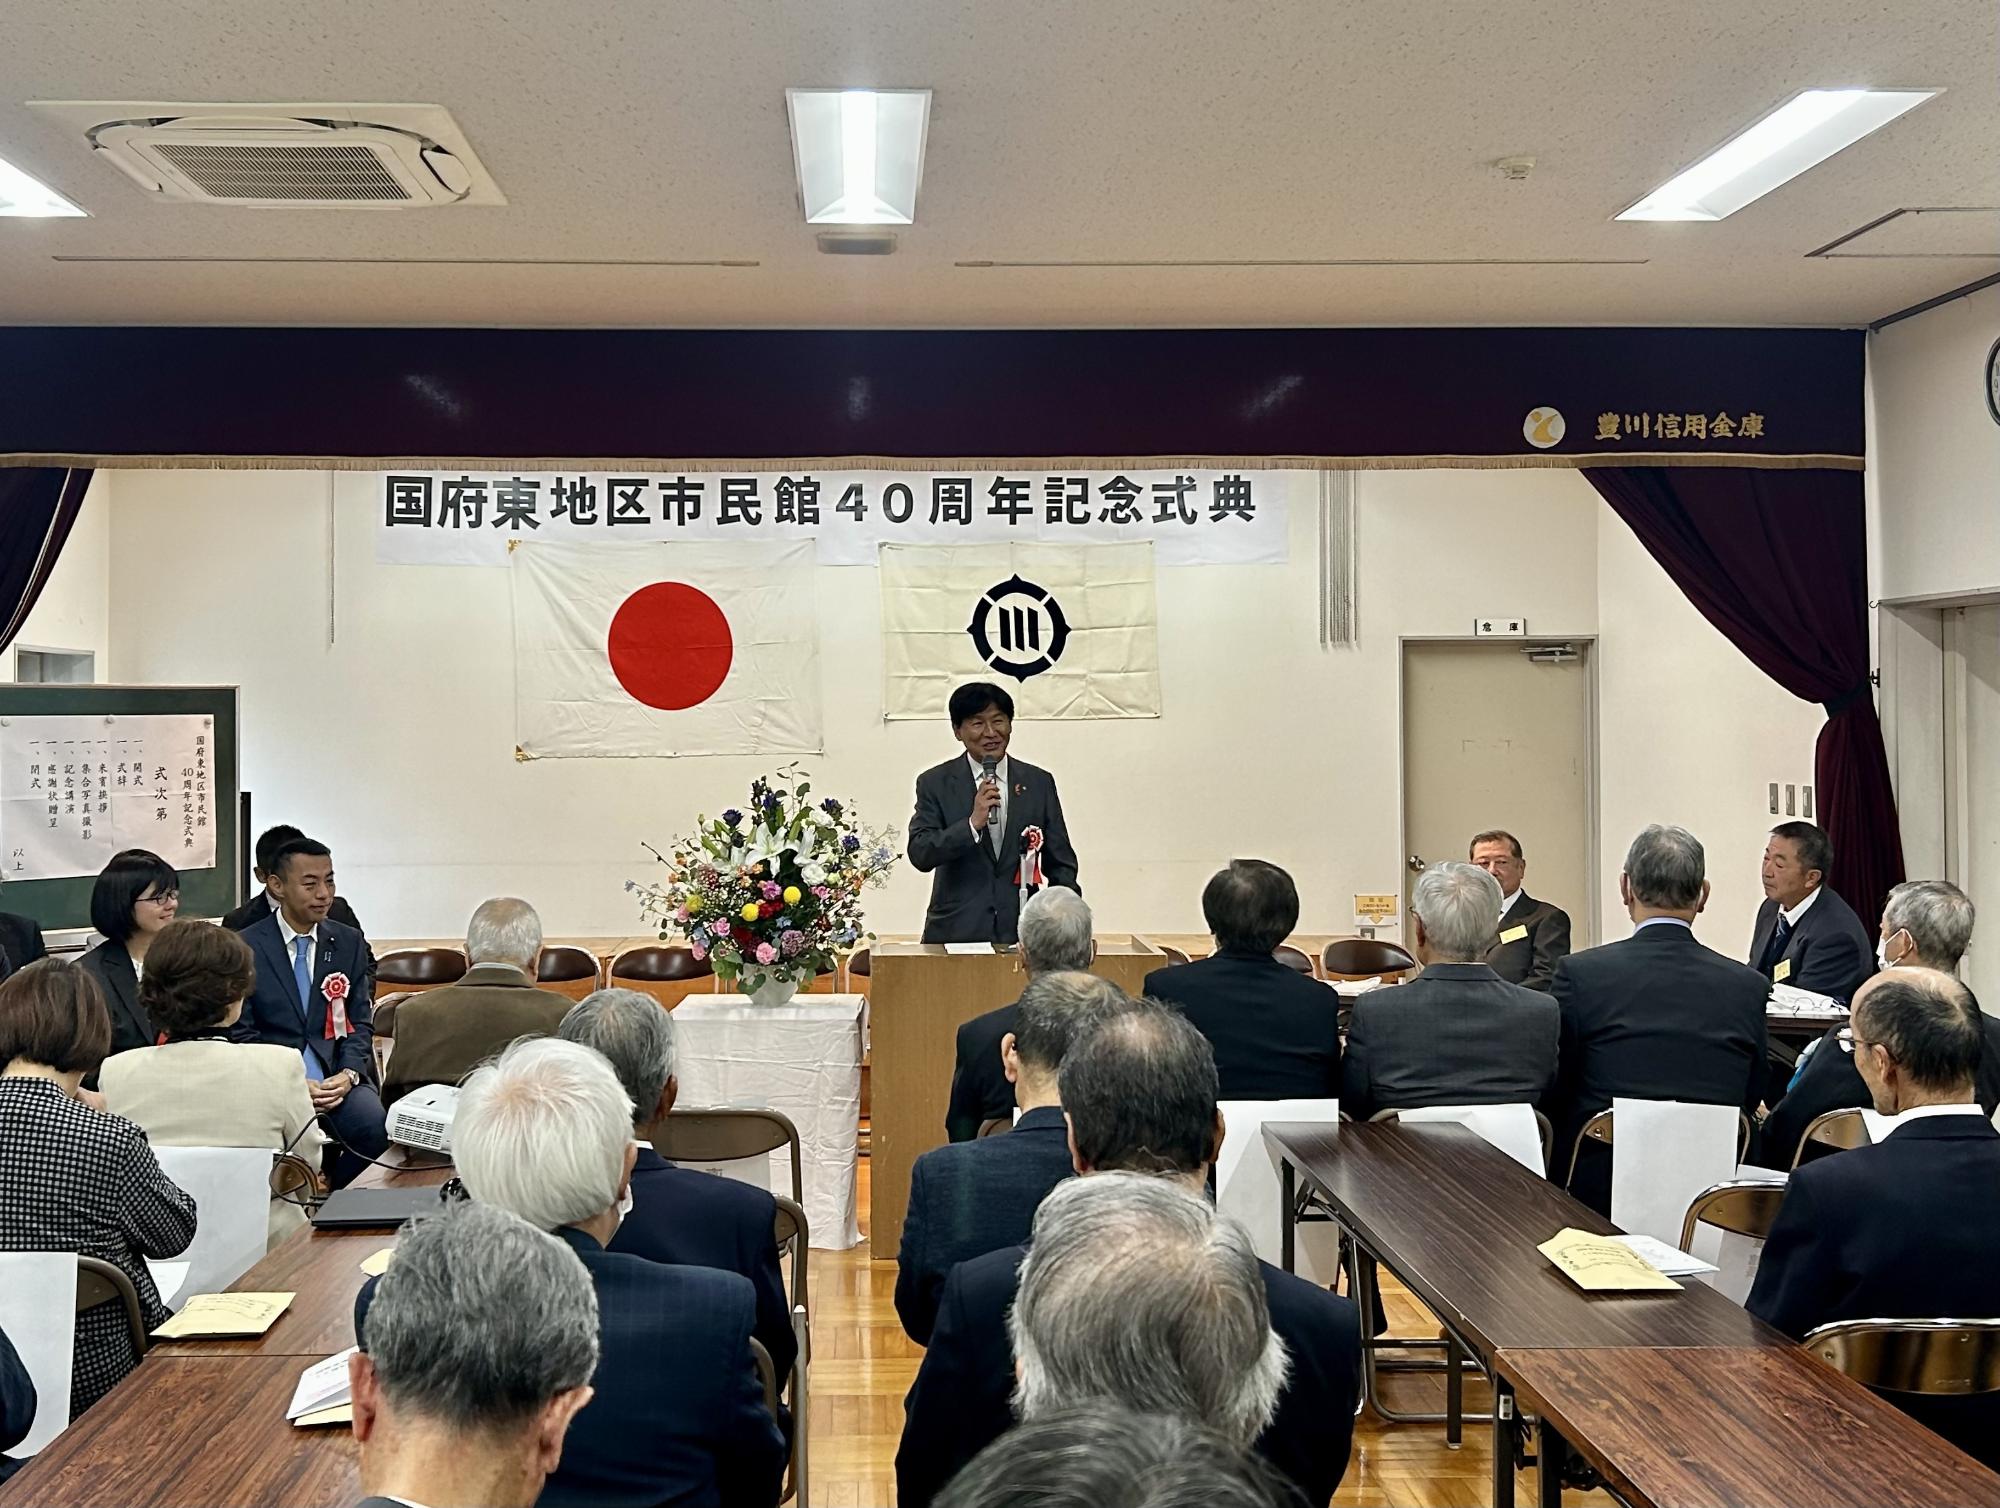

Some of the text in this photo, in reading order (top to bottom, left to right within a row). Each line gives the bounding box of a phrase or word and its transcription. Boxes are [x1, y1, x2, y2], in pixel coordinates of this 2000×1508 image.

[1595, 411, 1765, 441] 豊川信用金庫
[385, 474, 1257, 531] 国府東地区市民館40周年記念式典
[154, 766, 168, 821] 式次第
[181, 767, 194, 848] 40周年記念式典
[196, 735, 207, 827] 国府東地区市民館
[12, 848, 24, 871] 以上
